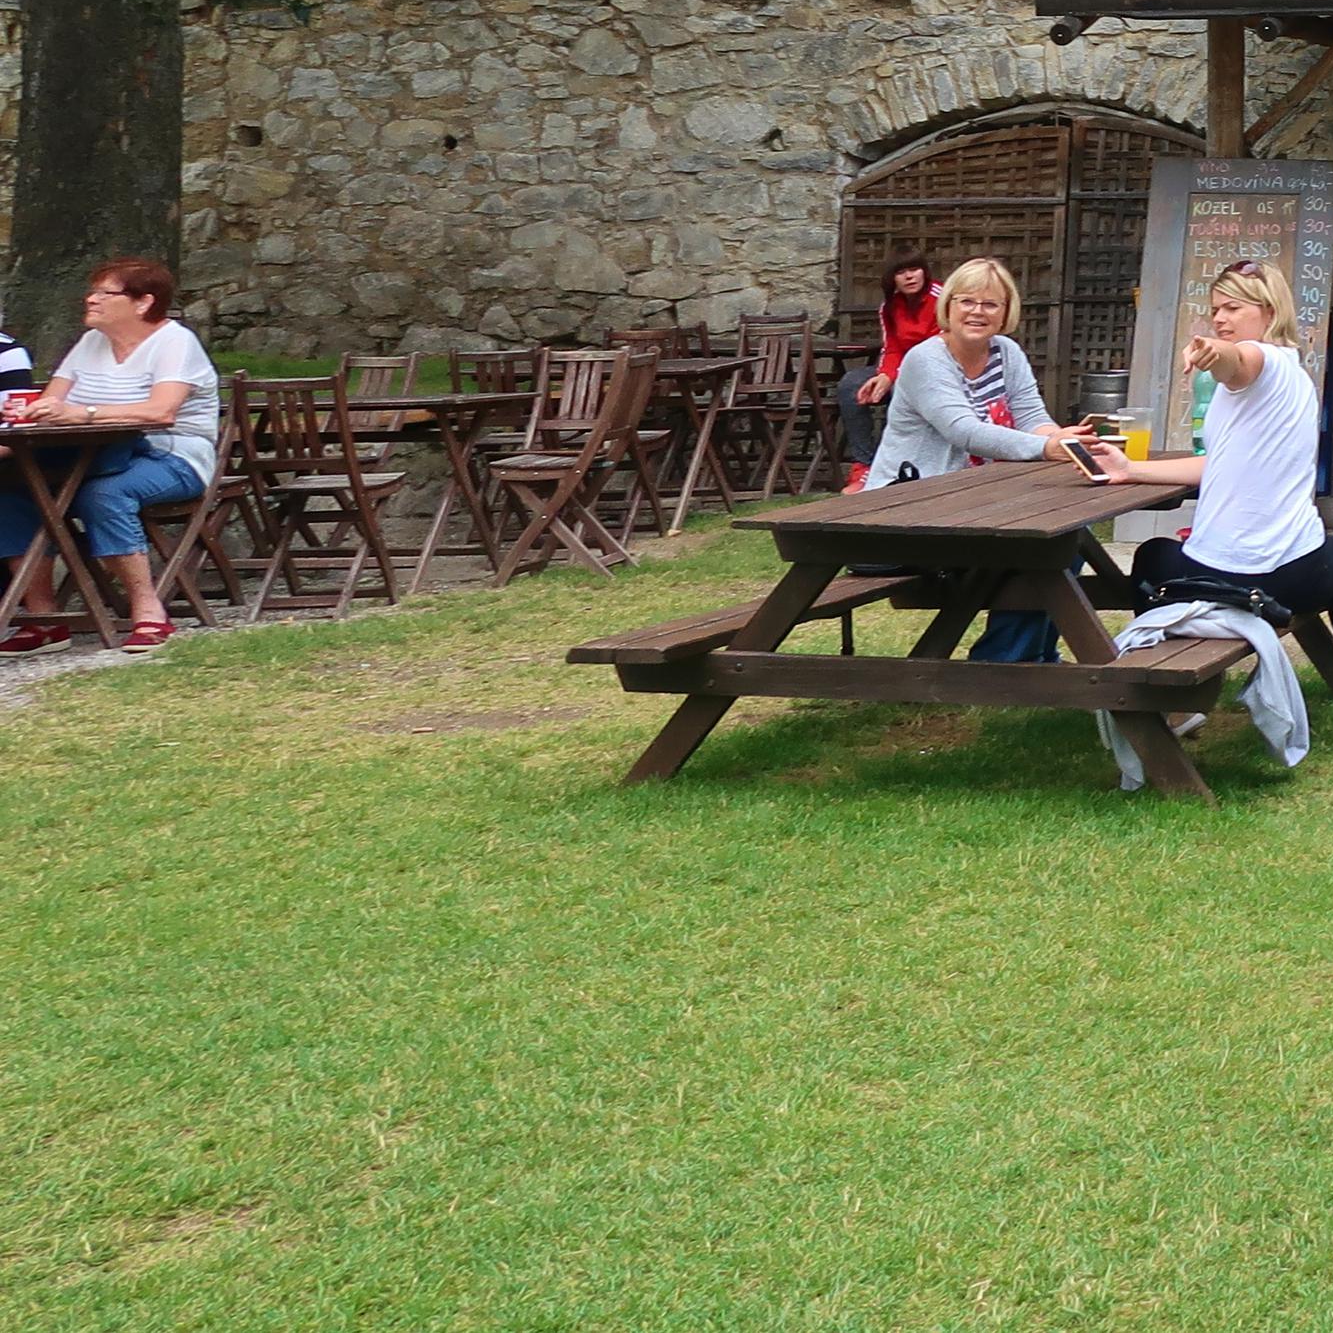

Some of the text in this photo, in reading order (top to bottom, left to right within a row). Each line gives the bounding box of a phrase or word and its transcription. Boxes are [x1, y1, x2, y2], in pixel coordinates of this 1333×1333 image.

[1196, 174, 1284, 190] MEDOVÍNA
[1192, 200, 1241, 216] KOZEL
[1247, 223, 1282, 237] LIMO
[1194, 241, 1282, 259] ESPRESSO
